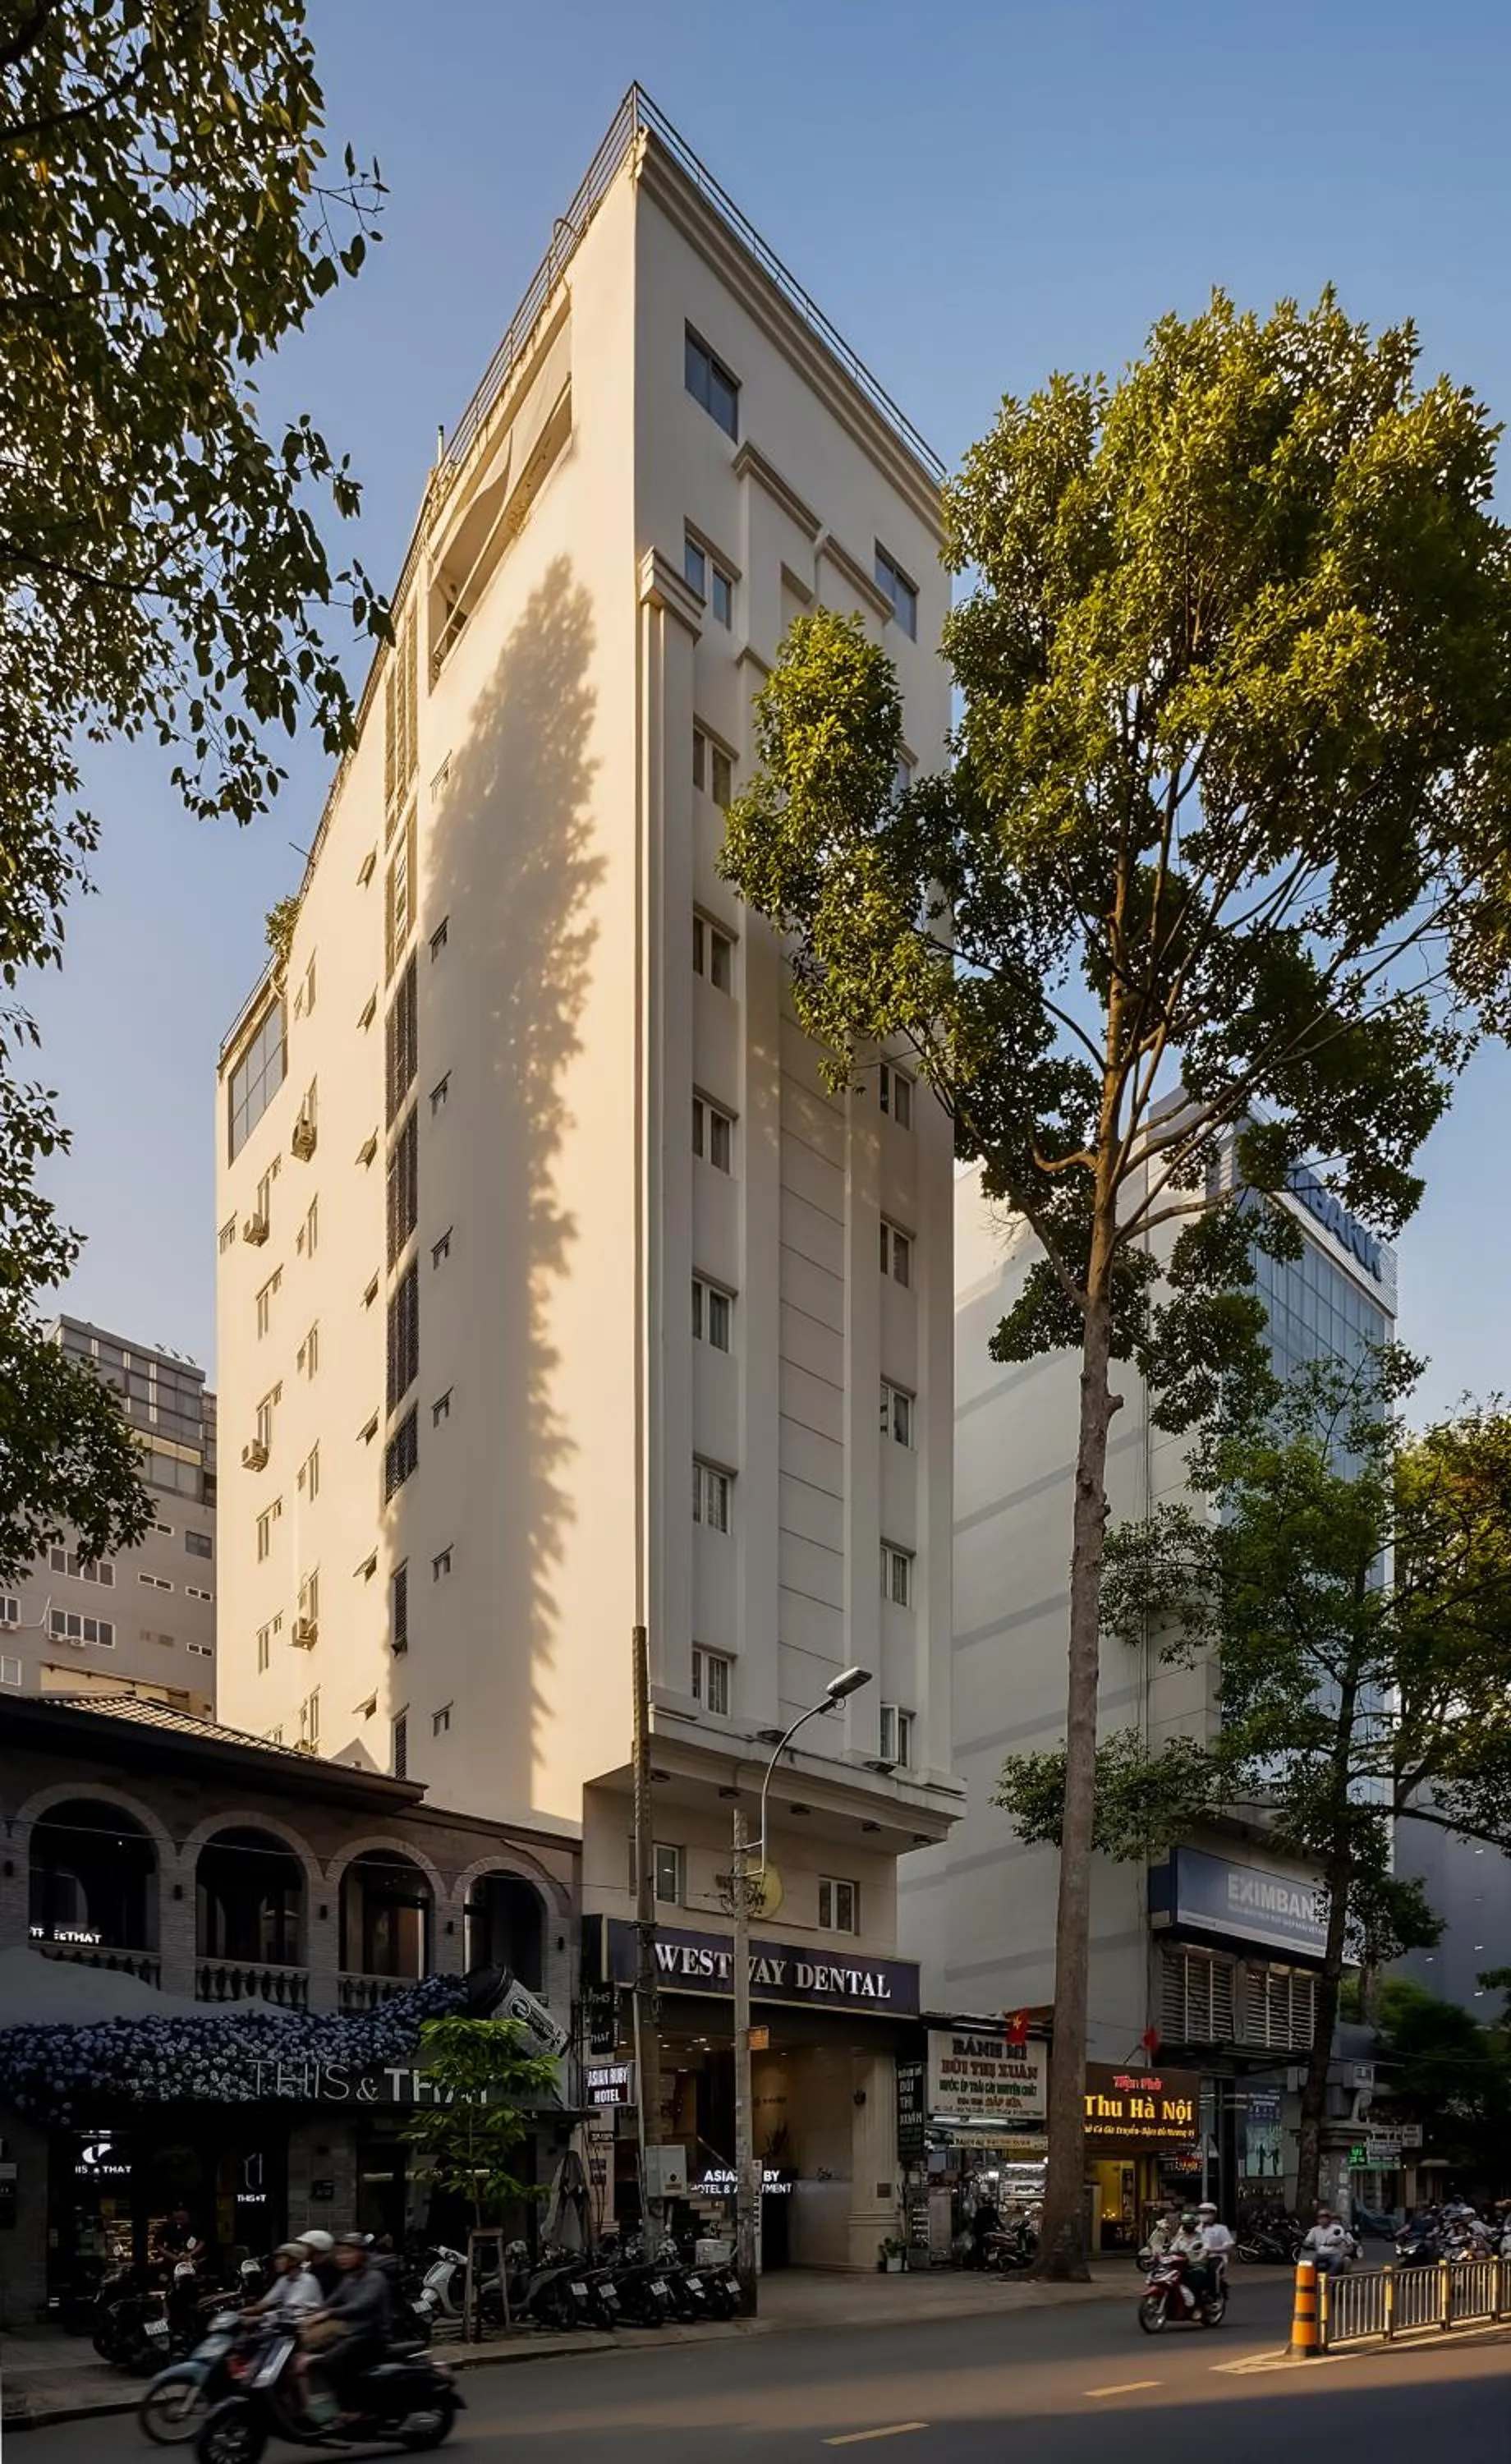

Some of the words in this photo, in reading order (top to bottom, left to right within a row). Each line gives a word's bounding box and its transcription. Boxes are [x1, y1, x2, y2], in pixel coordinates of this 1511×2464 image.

[795, 1963, 892, 1999] DENTAL
[246, 2059, 350, 2100] THIS
[356, 2077, 379, 2101] &
[594, 2089, 620, 2103] HOTEL
[1084, 2094, 1123, 2117] Thu
[1130, 2097, 1155, 2119] Hà
[1162, 2099, 1193, 2125] Nội
[101, 2164, 132, 2174] THAT
